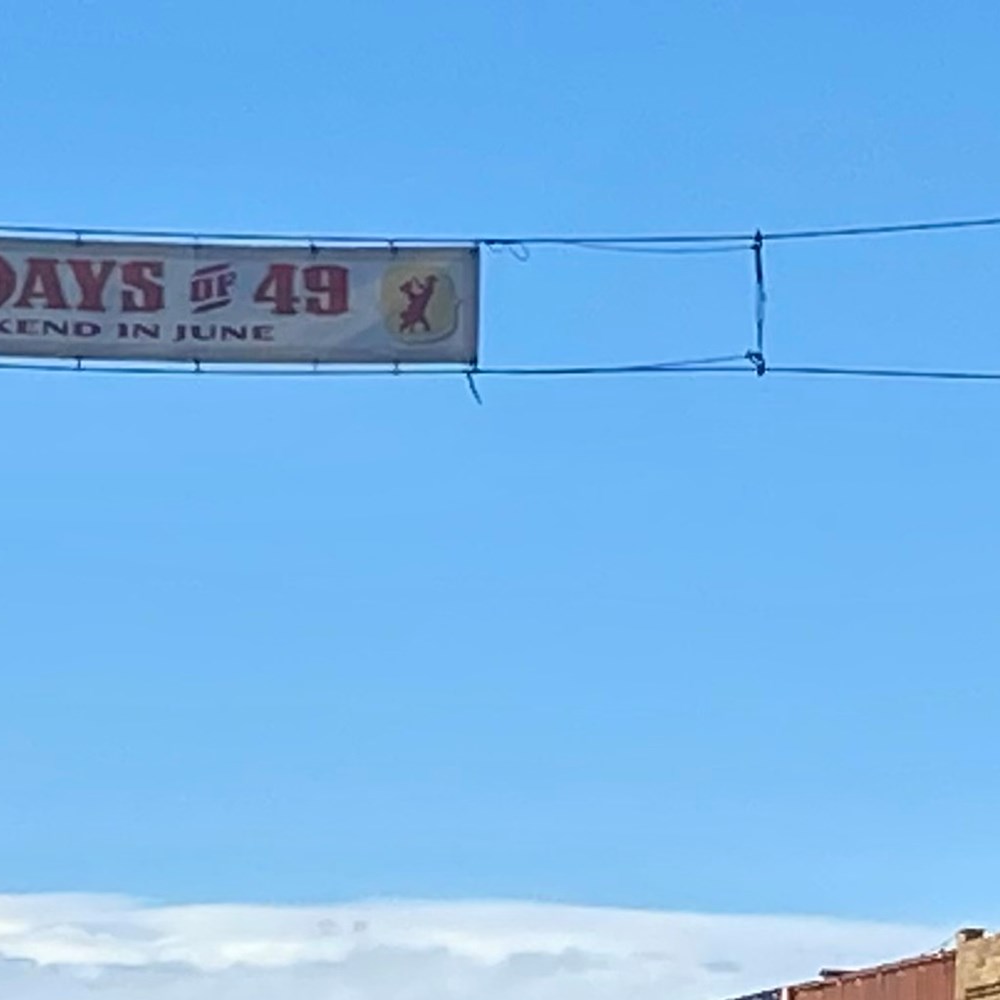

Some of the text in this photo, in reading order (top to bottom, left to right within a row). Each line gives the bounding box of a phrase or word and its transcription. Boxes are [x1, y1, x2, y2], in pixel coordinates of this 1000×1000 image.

[190, 271, 237, 302] OF
[253, 263, 350, 315] 49
[117, 322, 161, 339] IN
[172, 323, 275, 342] JUNE
